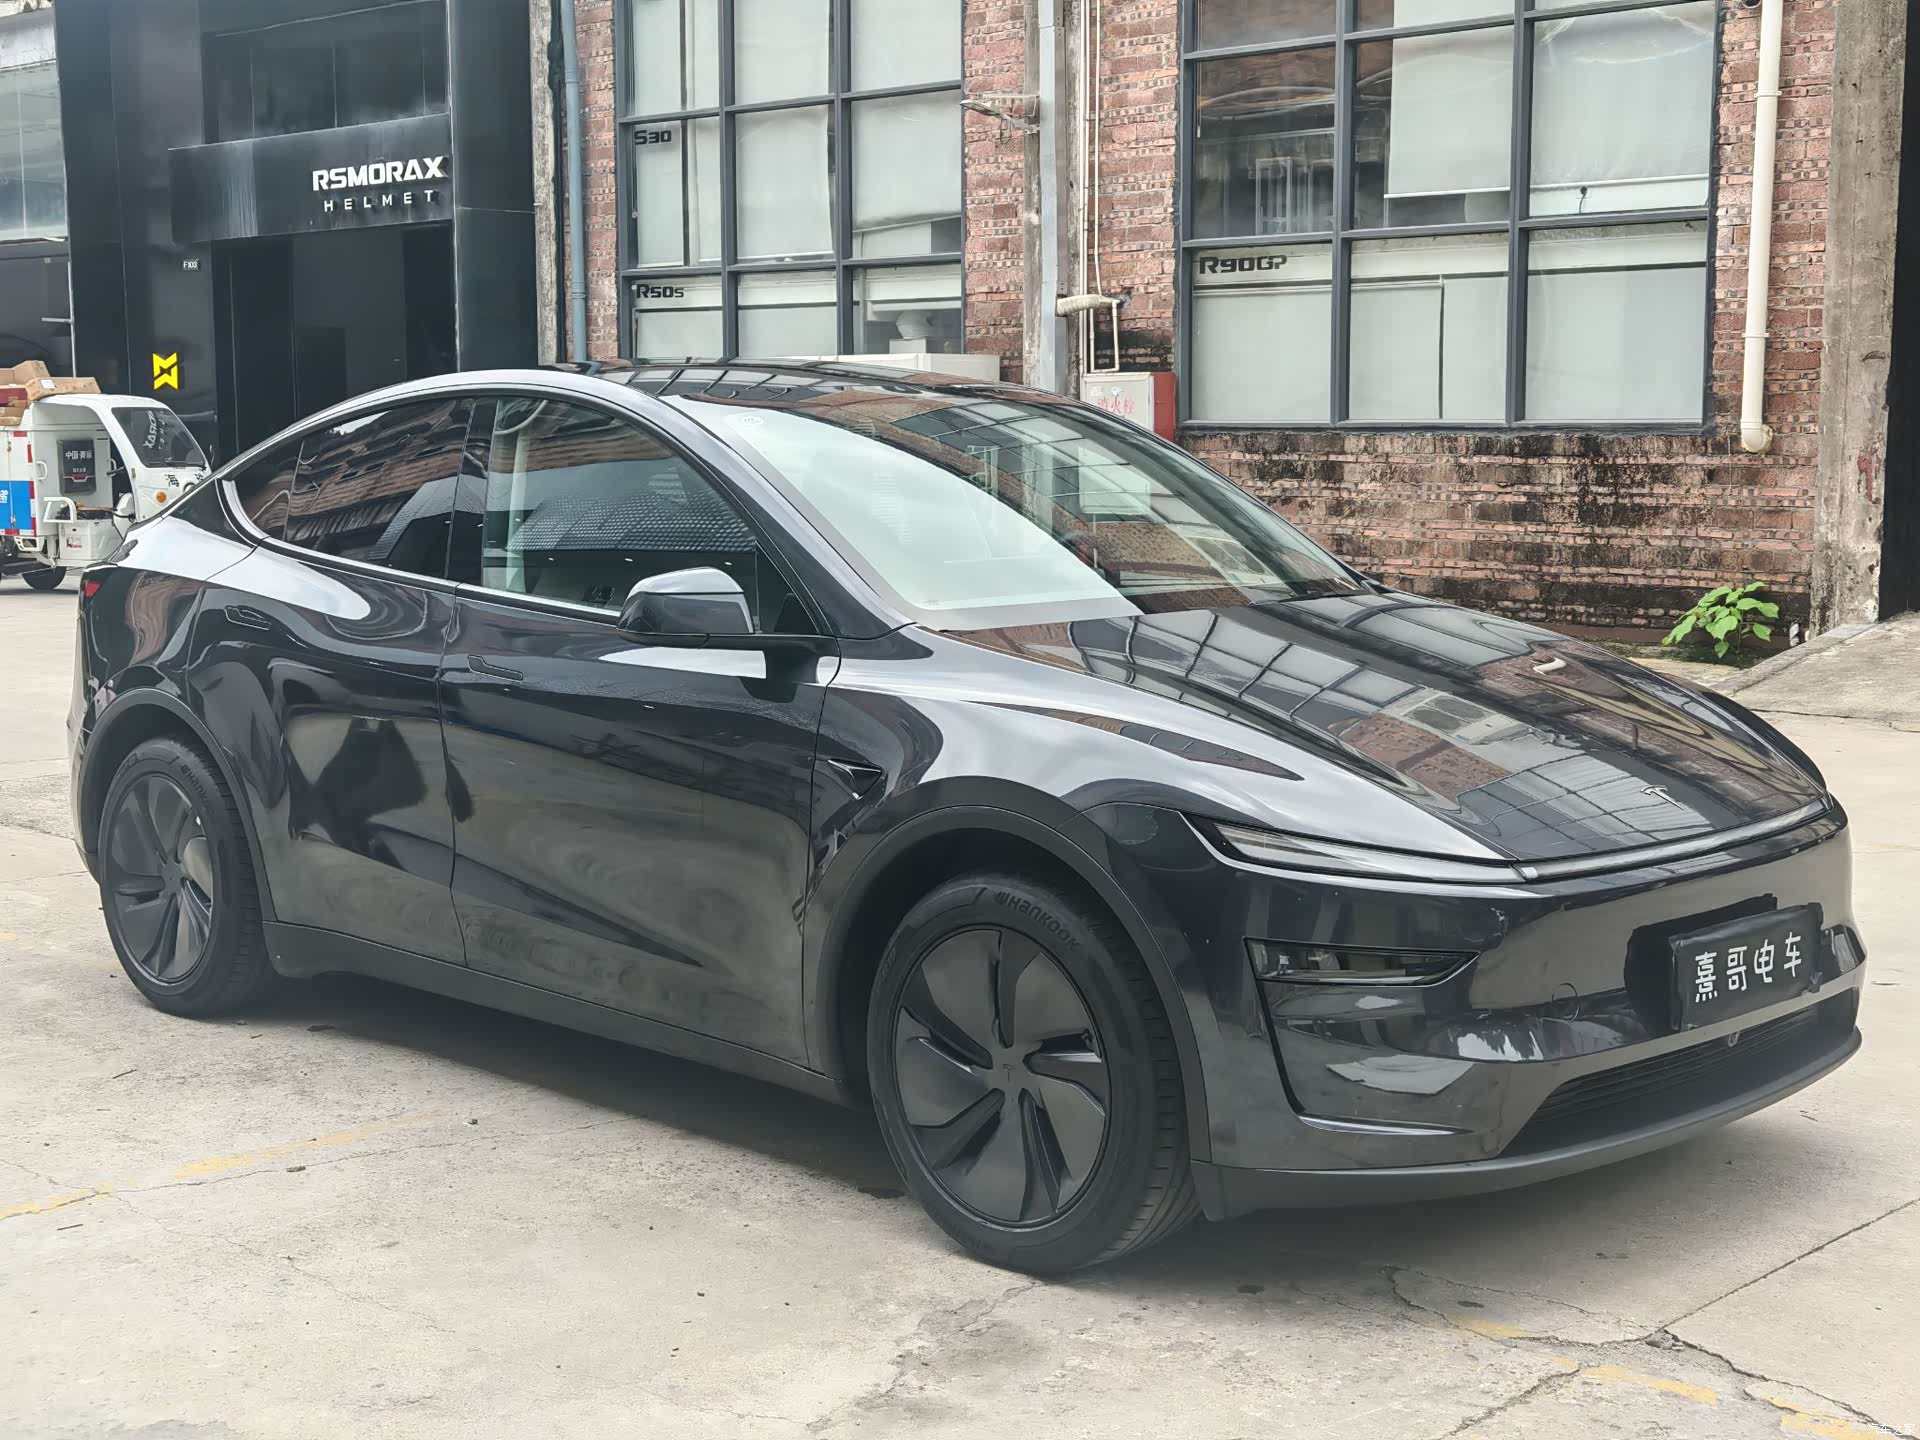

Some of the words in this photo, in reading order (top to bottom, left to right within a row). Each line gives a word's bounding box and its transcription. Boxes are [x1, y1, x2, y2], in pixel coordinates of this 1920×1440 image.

[634, 130, 672, 145] S30
[312, 156, 444, 191] RSMORAX
[323, 189, 434, 212] HELMET
[1199, 254, 1287, 274] R90GP
[1695, 931, 1802, 1003] 熹哥电车
